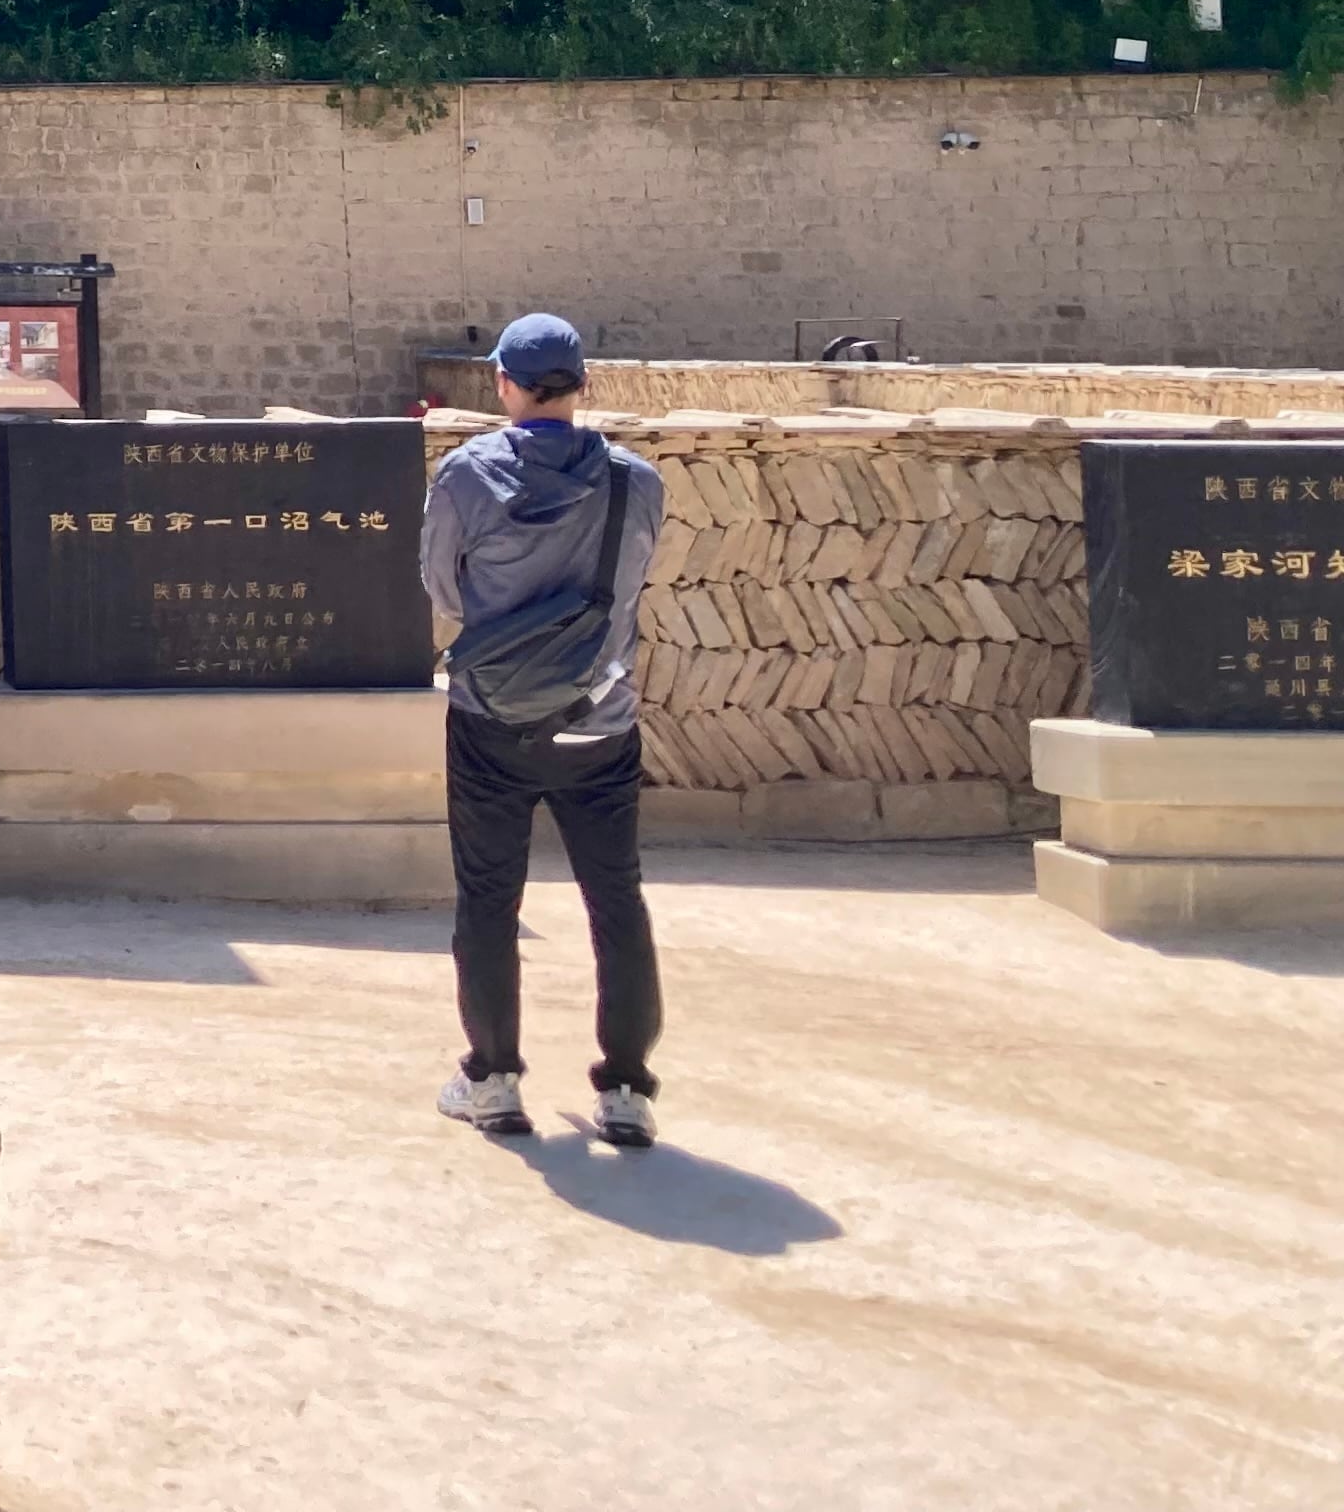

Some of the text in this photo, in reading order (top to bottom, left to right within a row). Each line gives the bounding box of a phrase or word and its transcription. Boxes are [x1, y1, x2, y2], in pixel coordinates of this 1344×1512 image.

[123, 441, 315, 465] 陕西省文物保护单位
[49, 510, 390, 533] 陕西省第一口沼气池
[153, 579, 308, 600] 陕西省人民政府
